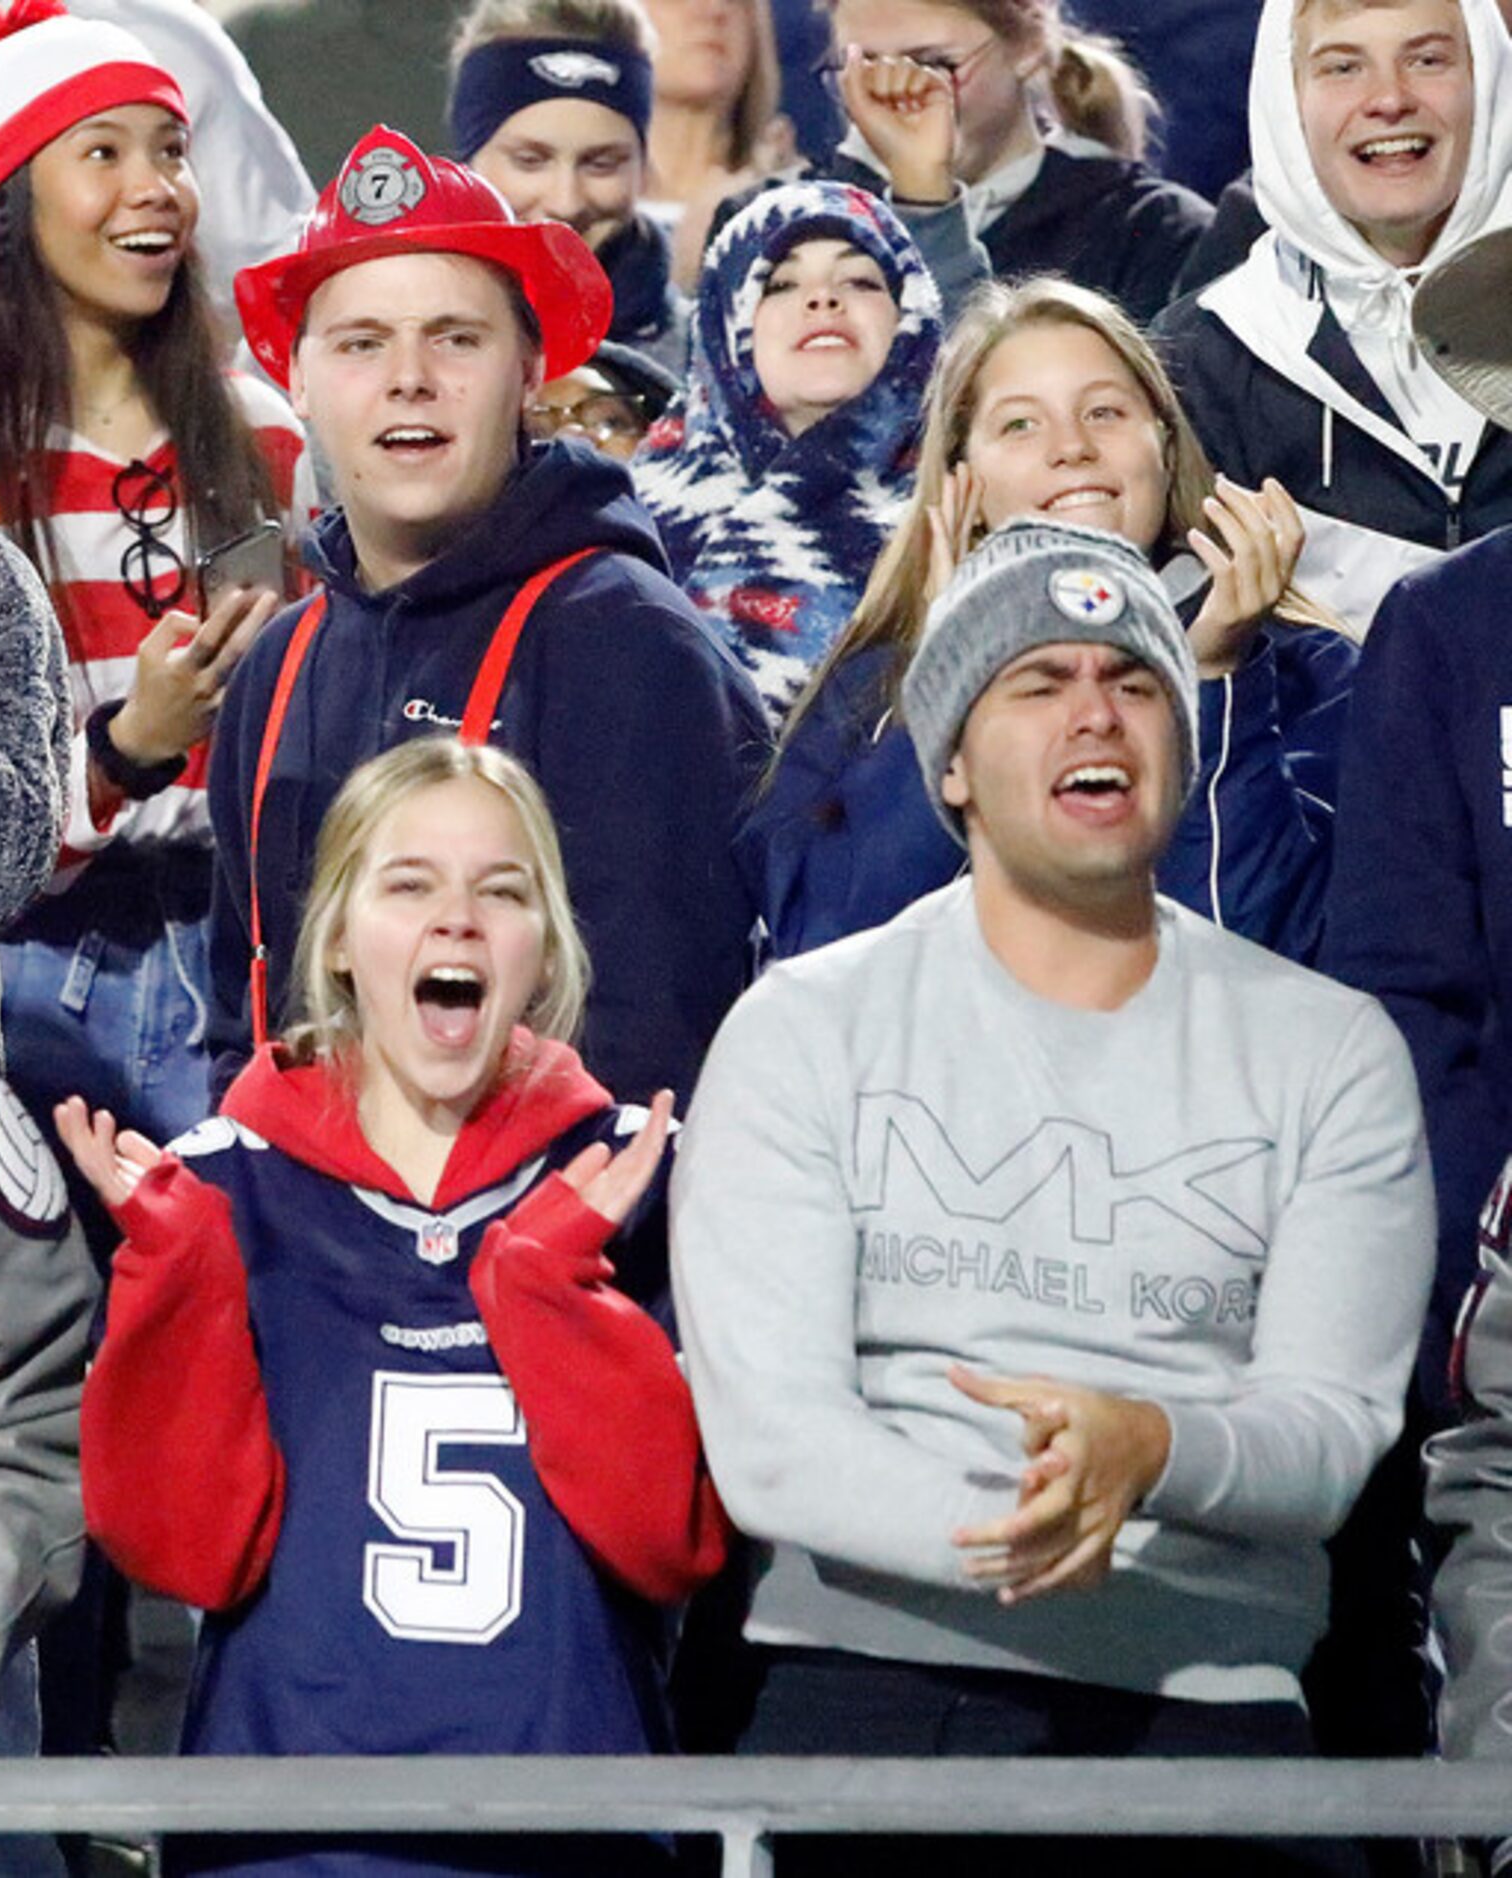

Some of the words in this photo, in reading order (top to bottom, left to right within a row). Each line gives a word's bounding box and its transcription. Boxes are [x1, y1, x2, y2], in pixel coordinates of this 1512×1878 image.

[371, 173, 390, 199] 7
[851, 1089, 1276, 1261] MK
[858, 1230, 1106, 1315] MICHAEL
[1130, 1271, 1258, 1324] KOR
[363, 1370, 527, 1645] 5
